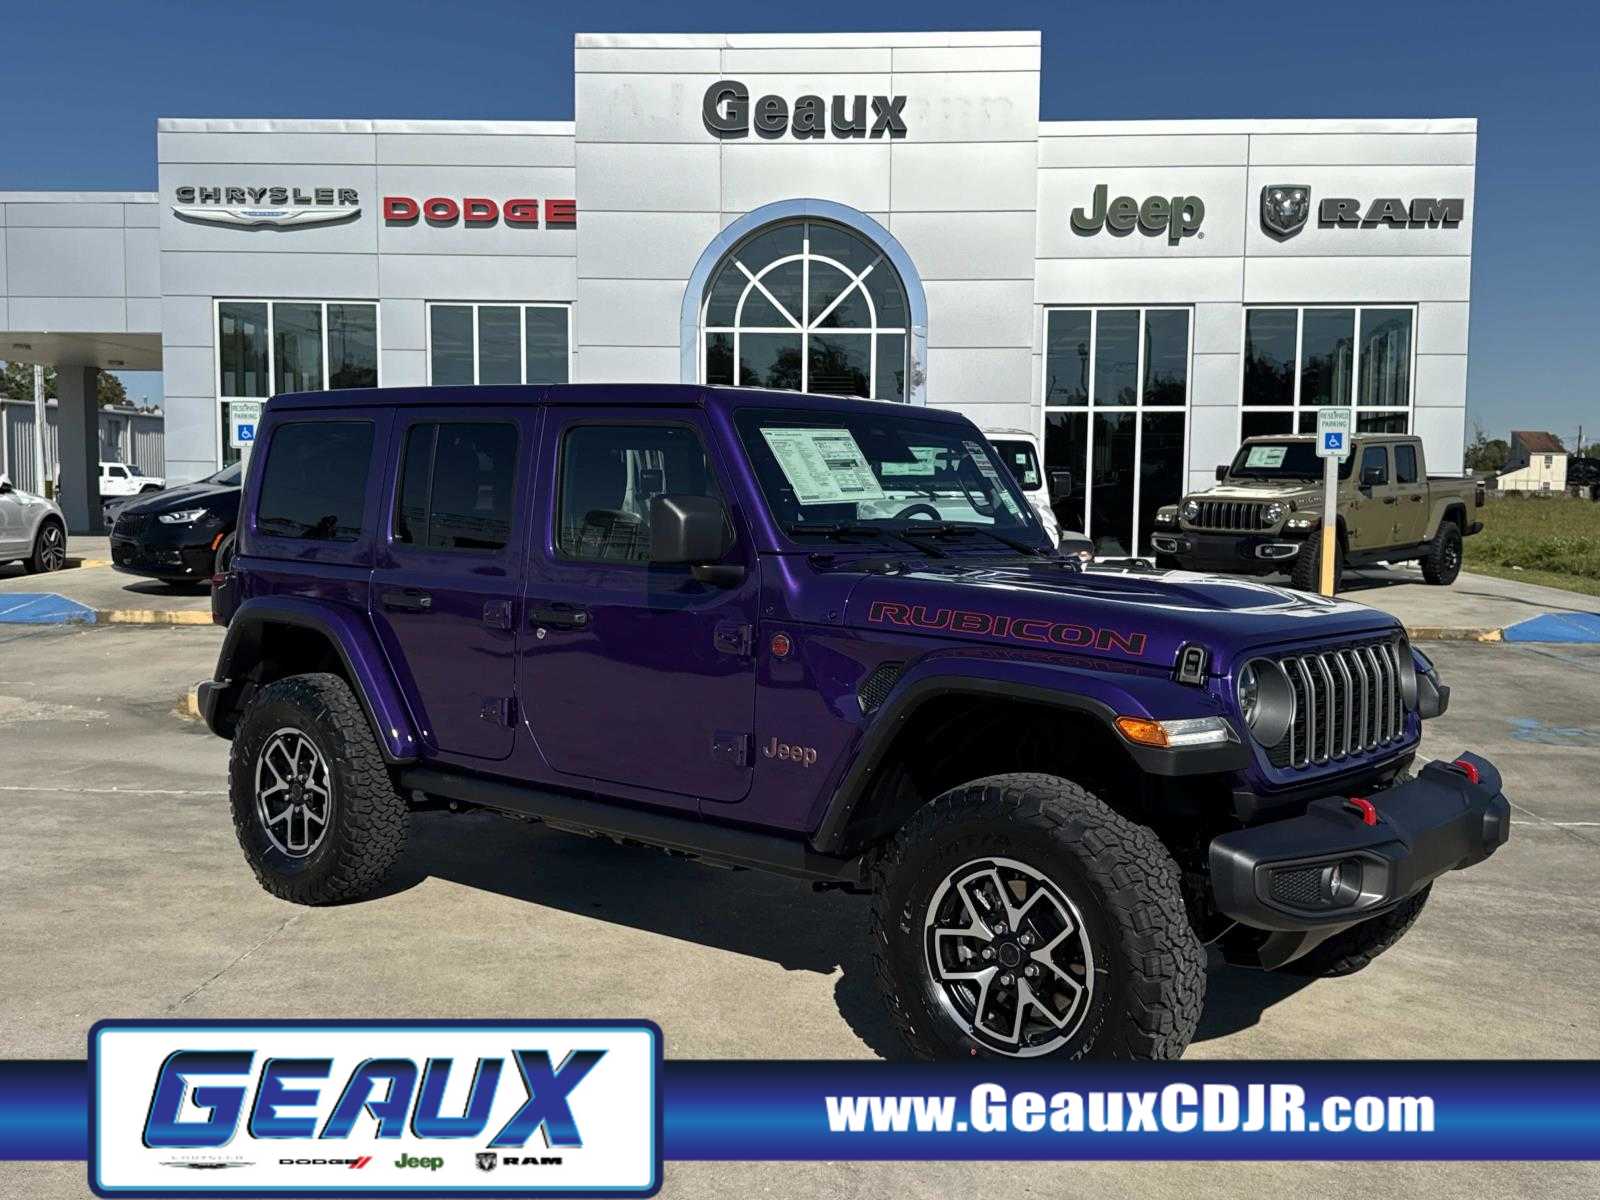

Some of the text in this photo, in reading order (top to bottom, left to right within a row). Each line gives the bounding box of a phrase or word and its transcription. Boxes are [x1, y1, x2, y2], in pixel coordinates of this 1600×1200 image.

[702, 80, 907, 139] Geaux
[175, 185, 361, 206] CHRYSLER
[383, 196, 576, 228] DODGE
[1070, 184, 1205, 246] Jeep
[1318, 198, 1465, 229] RAM
[868, 601, 1147, 656] RUBICON
[762, 736, 818, 768] Jeep
